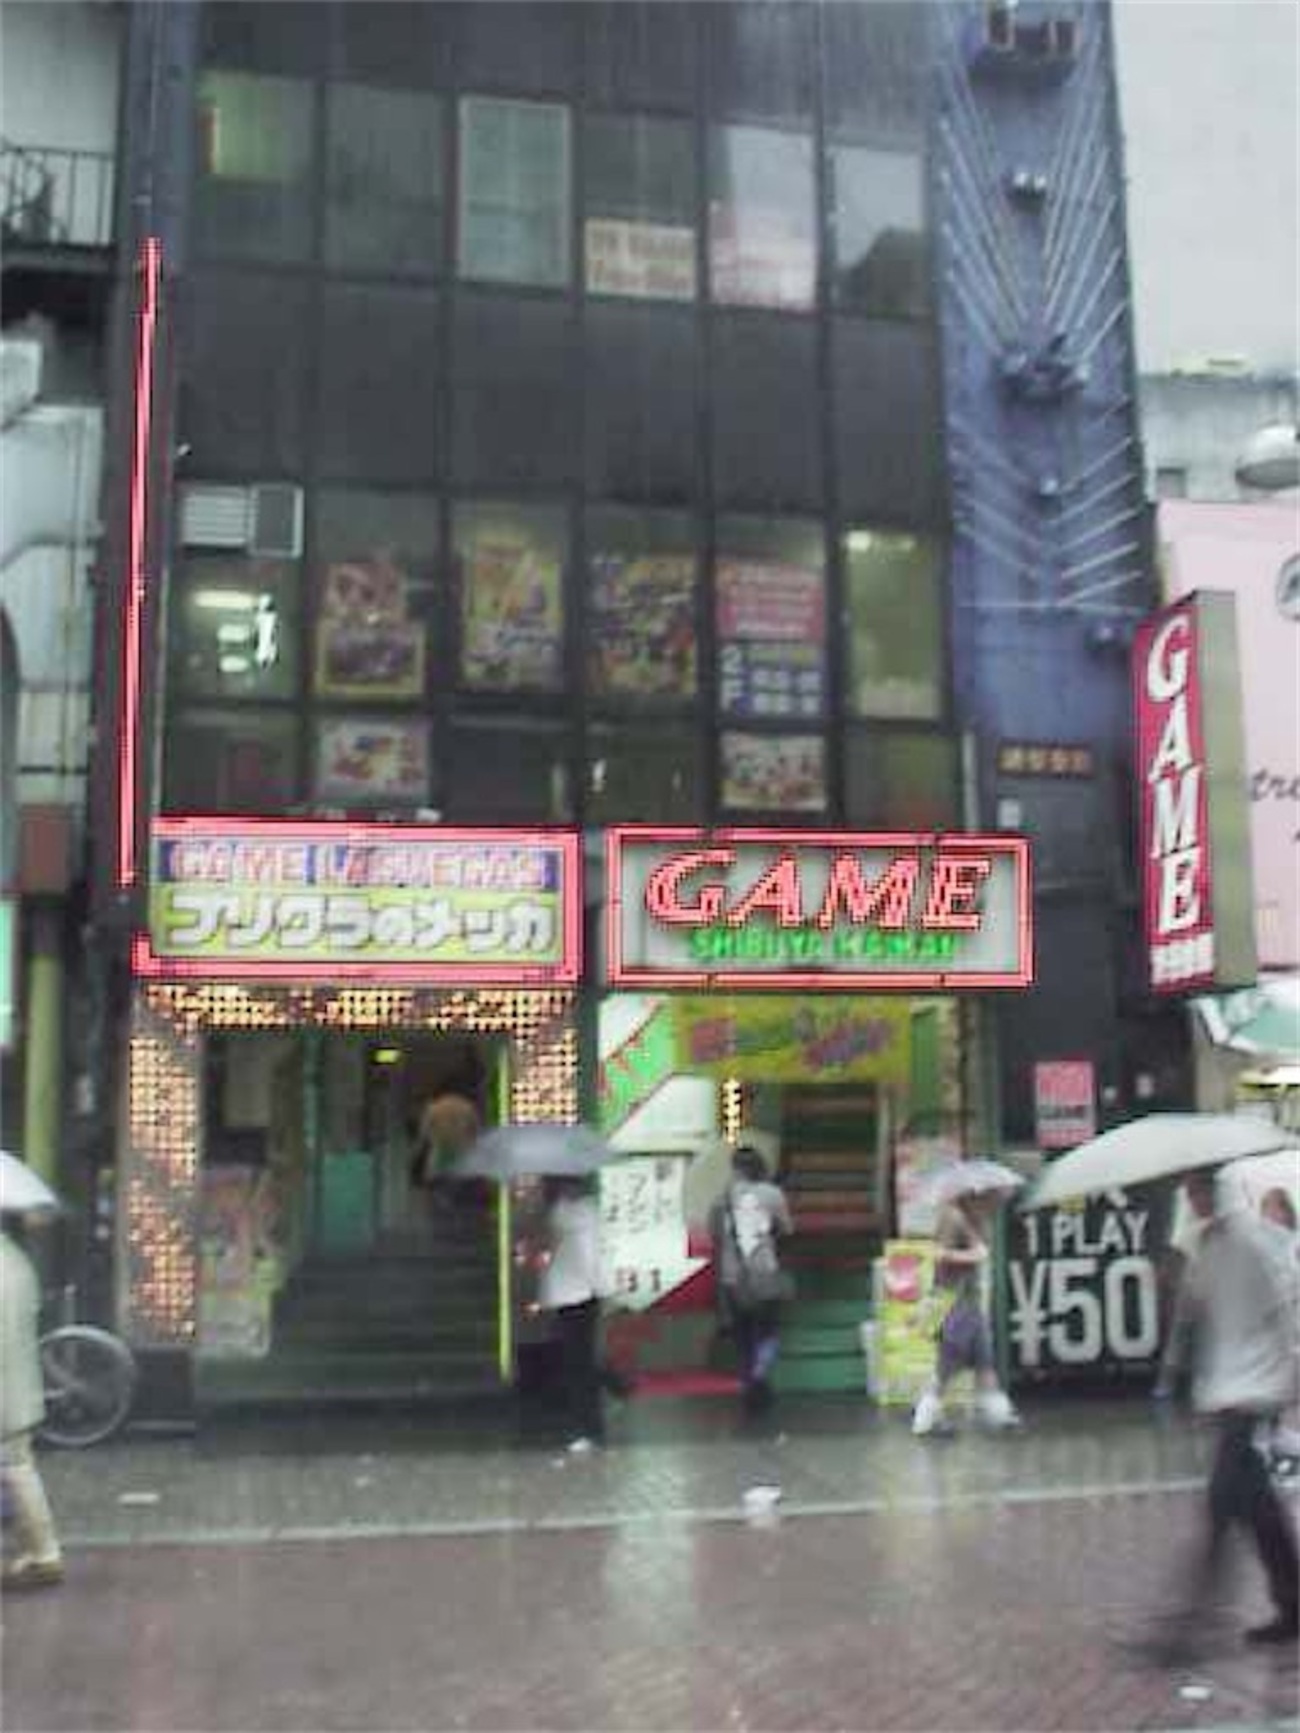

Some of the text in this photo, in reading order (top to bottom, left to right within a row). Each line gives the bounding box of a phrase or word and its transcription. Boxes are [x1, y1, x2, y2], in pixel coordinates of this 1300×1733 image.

[1147, 613, 1201, 933] GAME
[646, 847, 991, 929] GAME
[1023, 1211, 1148, 1255] 1 PLAY
[1009, 1257, 1158, 1366] ¥50
